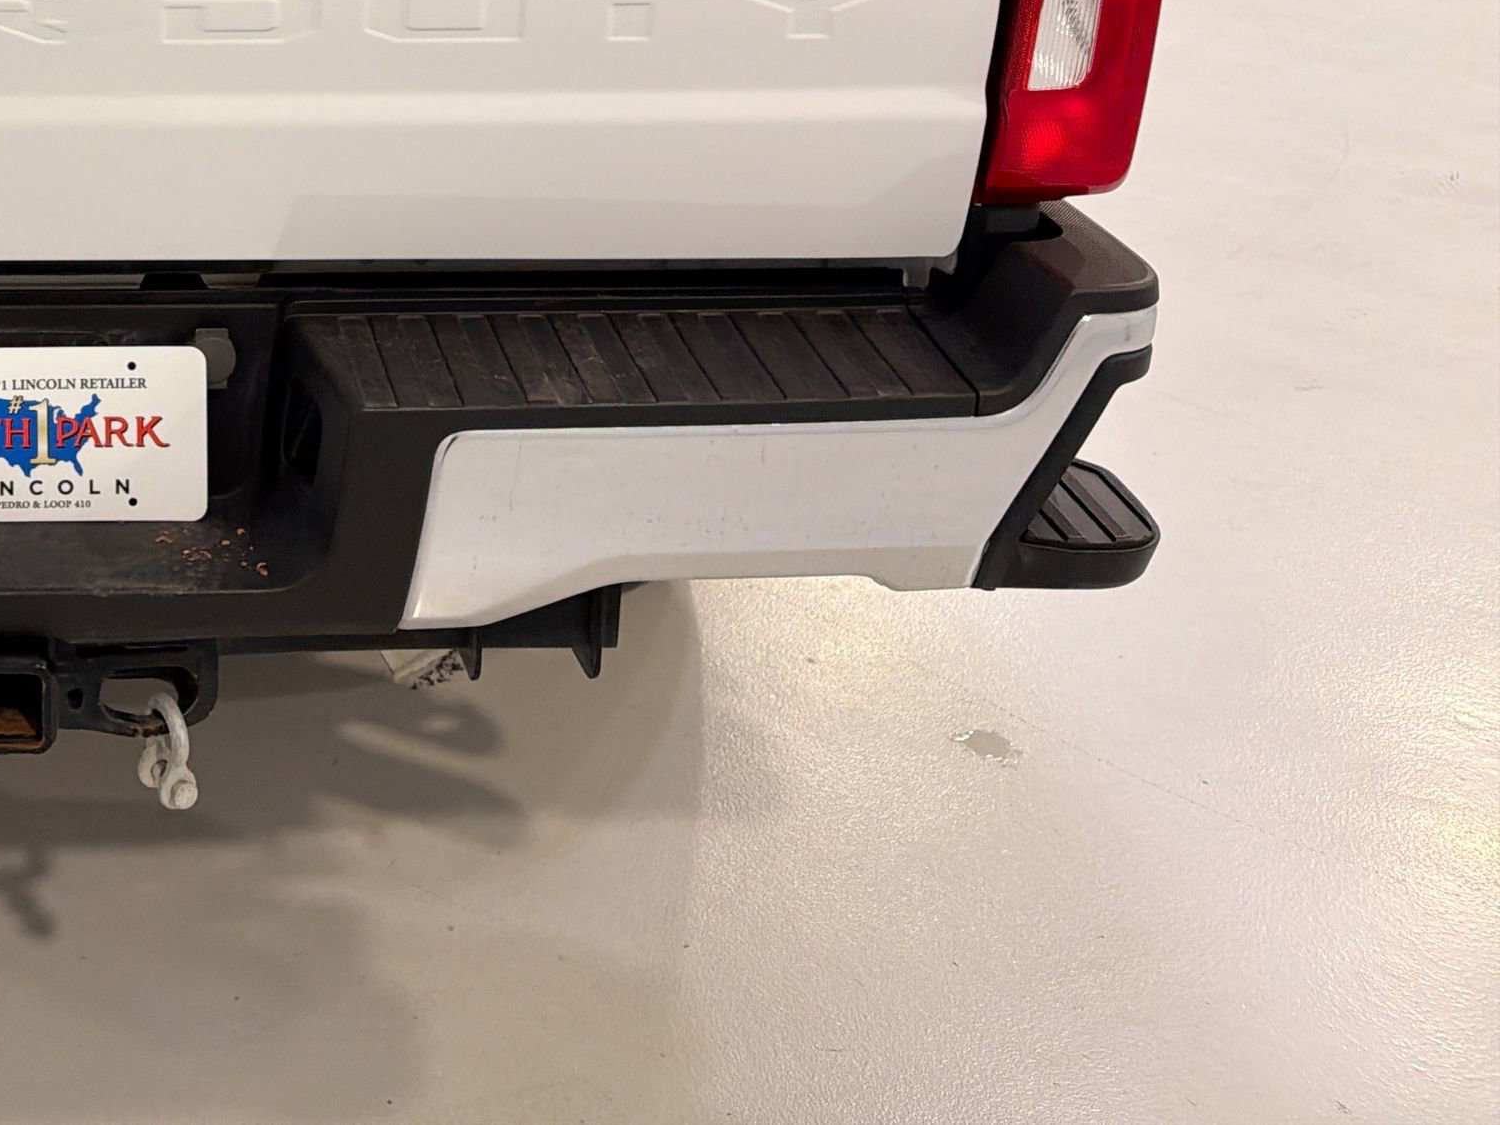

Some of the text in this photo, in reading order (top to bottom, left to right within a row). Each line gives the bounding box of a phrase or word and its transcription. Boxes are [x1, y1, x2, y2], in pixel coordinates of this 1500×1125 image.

[12, 378, 76, 390] LINCOLN
[80, 377, 148, 389] RETAILER
[55, 416, 171, 448] PARK
[32, 500, 41, 509] &
[44, 500, 72, 509] LOOP
[74, 499, 91, 508] 410
